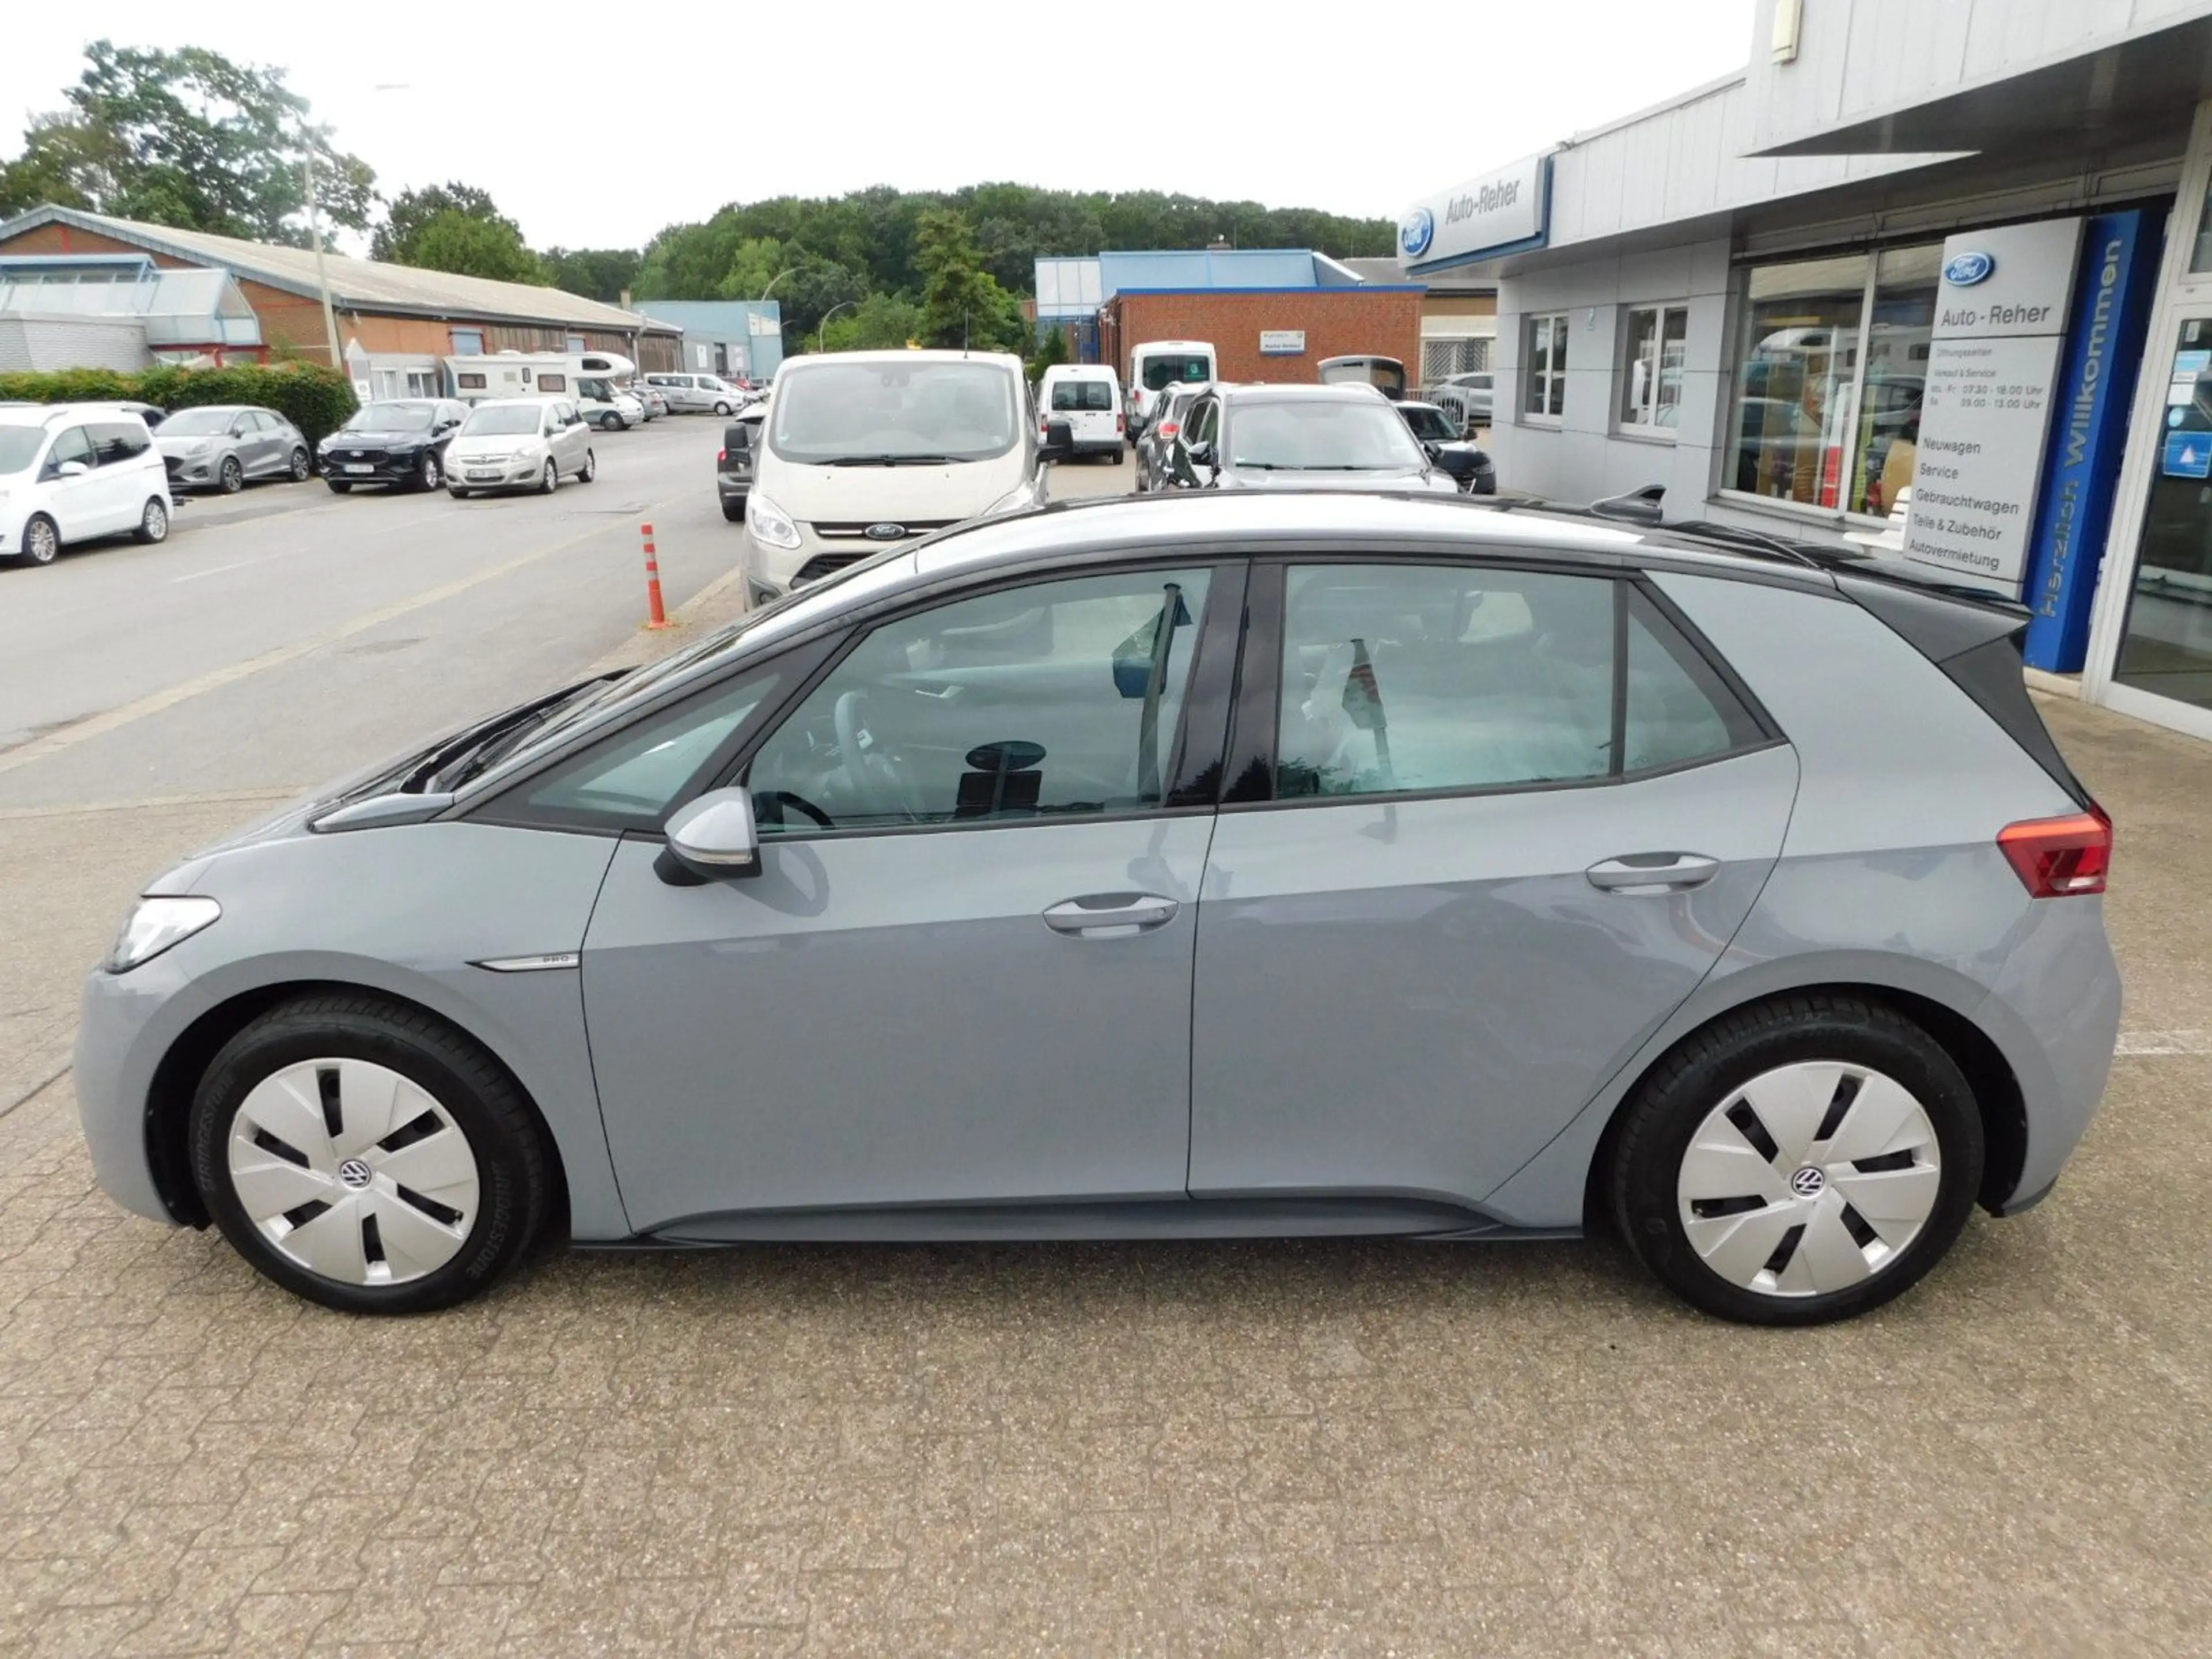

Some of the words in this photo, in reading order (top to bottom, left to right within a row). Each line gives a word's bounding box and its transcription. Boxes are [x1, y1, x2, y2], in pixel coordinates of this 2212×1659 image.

[1445, 178, 1521, 225] Auto-Reher
[1941, 309, 1976, 327] Auto
[1989, 303, 2051, 325] Reher
[2039, 479, 2079, 618] Herzlich
[2064, 238, 2123, 468] Willkommen
[1923, 437, 1981, 456] Neuwagen
[1920, 463, 1959, 479] Service
[1916, 488, 2019, 515] Gebrauchtwagen
[1914, 513, 1936, 529] Teile
[1937, 519, 1945, 531] &
[1947, 520, 2002, 540] Zubehör
[1909, 539, 2000, 571] Autovermietung
[543, 955, 569, 964] PRO
